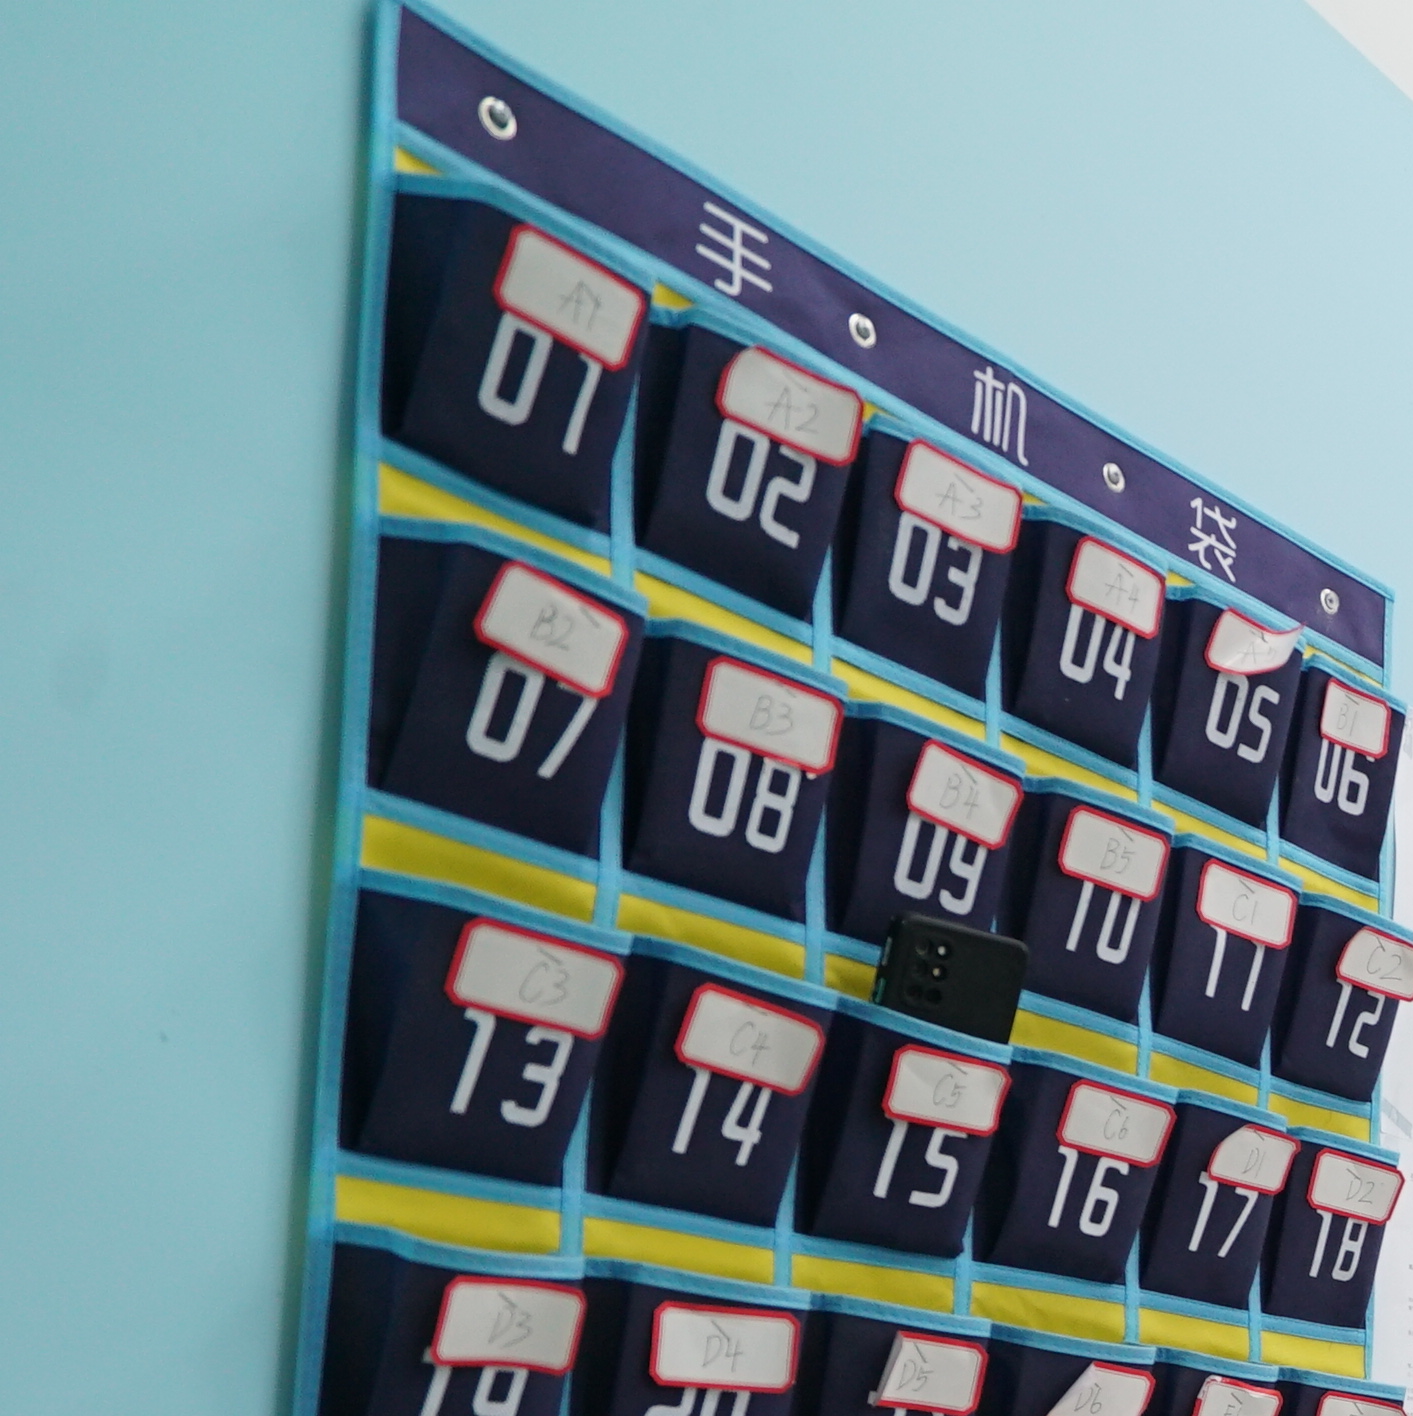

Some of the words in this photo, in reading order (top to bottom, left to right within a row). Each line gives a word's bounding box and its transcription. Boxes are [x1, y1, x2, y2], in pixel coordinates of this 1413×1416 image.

[478, 311, 603, 455] 01
[706, 418, 816, 549] 02
[888, 511, 983, 626] 03
[1059, 603, 1136, 701] 04
[466, 657, 598, 779] 07
[1205, 671, 1281, 764] 05
[688, 737, 802, 853] 08
[1313, 738, 1370, 816] 06
[893, 811, 988, 916] 09
[1065, 880, 1141, 965] 10
[1205, 924, 1266, 1012] 11
[1325, 978, 1386, 1059] 12
[450, 1007, 573, 1127] 13
[672, 1066, 772, 1166] 14
[872, 1118, 967, 1208] 15
[1048, 1145, 1130, 1237] 16
[1188, 1171, 1259, 1258] 17
[1308, 1209, 1369, 1282] 18
